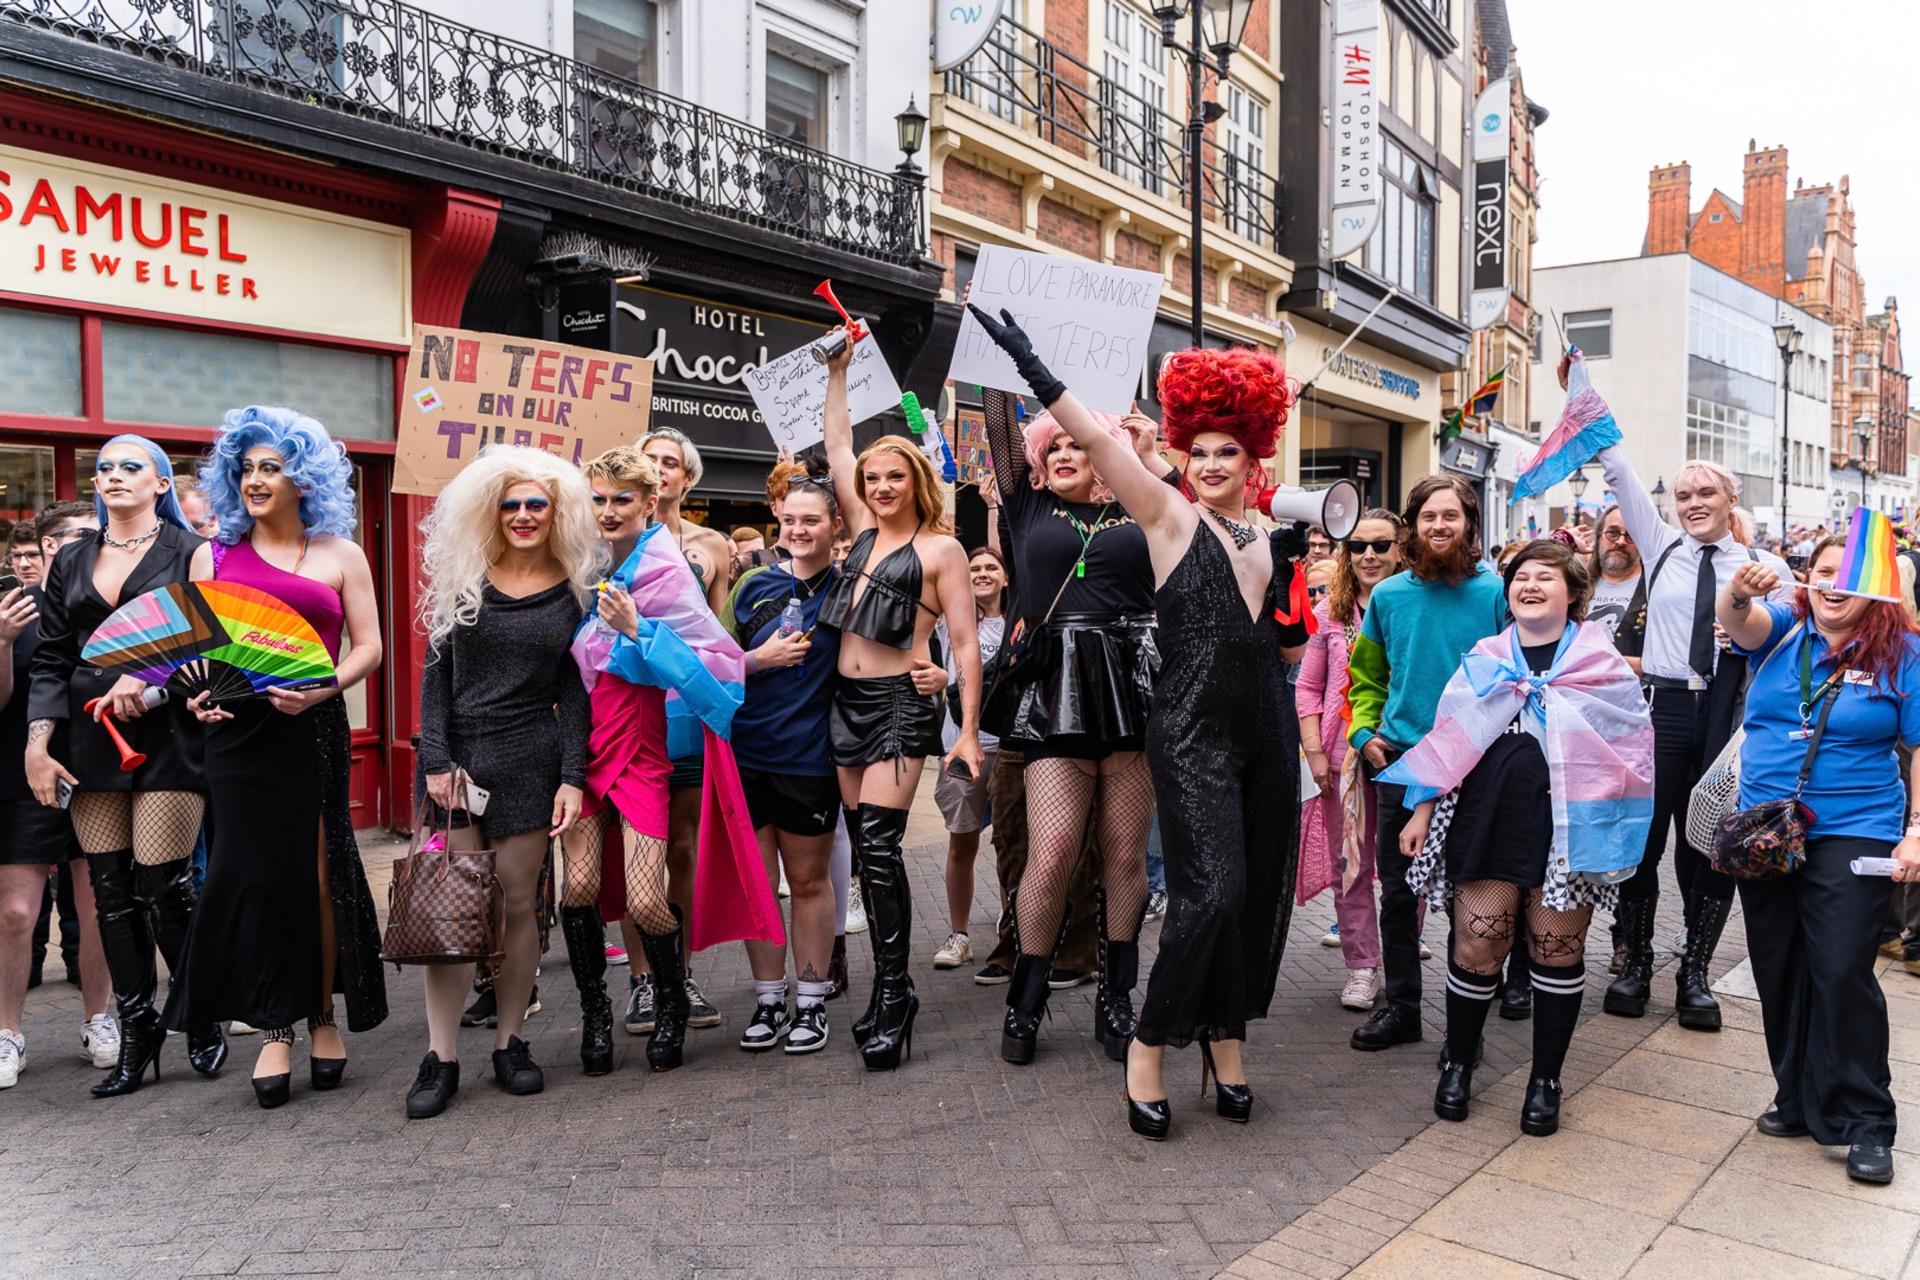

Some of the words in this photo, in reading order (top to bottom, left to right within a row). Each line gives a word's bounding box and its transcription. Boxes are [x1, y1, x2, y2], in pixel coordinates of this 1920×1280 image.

[1340, 101, 1353, 188] TOPMAN
[1359, 91, 1371, 192] TOPSHOP
[1477, 182, 1503, 267] next
[34, 243, 259, 300] JEWELLER
[979, 250, 1063, 300] LOVE
[1067, 265, 1154, 311] PARAMORE
[695, 305, 766, 337] HOTEL
[1048, 320, 1137, 378] TERFS
[420, 335, 481, 384] NO
[502, 343, 634, 403] TERFS
[478, 392, 514, 418] ON
[522, 397, 573, 428] OUR
[652, 396, 700, 417] BRITISH
[703, 403, 750, 422] COCOA
[240, 630, 304, 653] Fabulous
